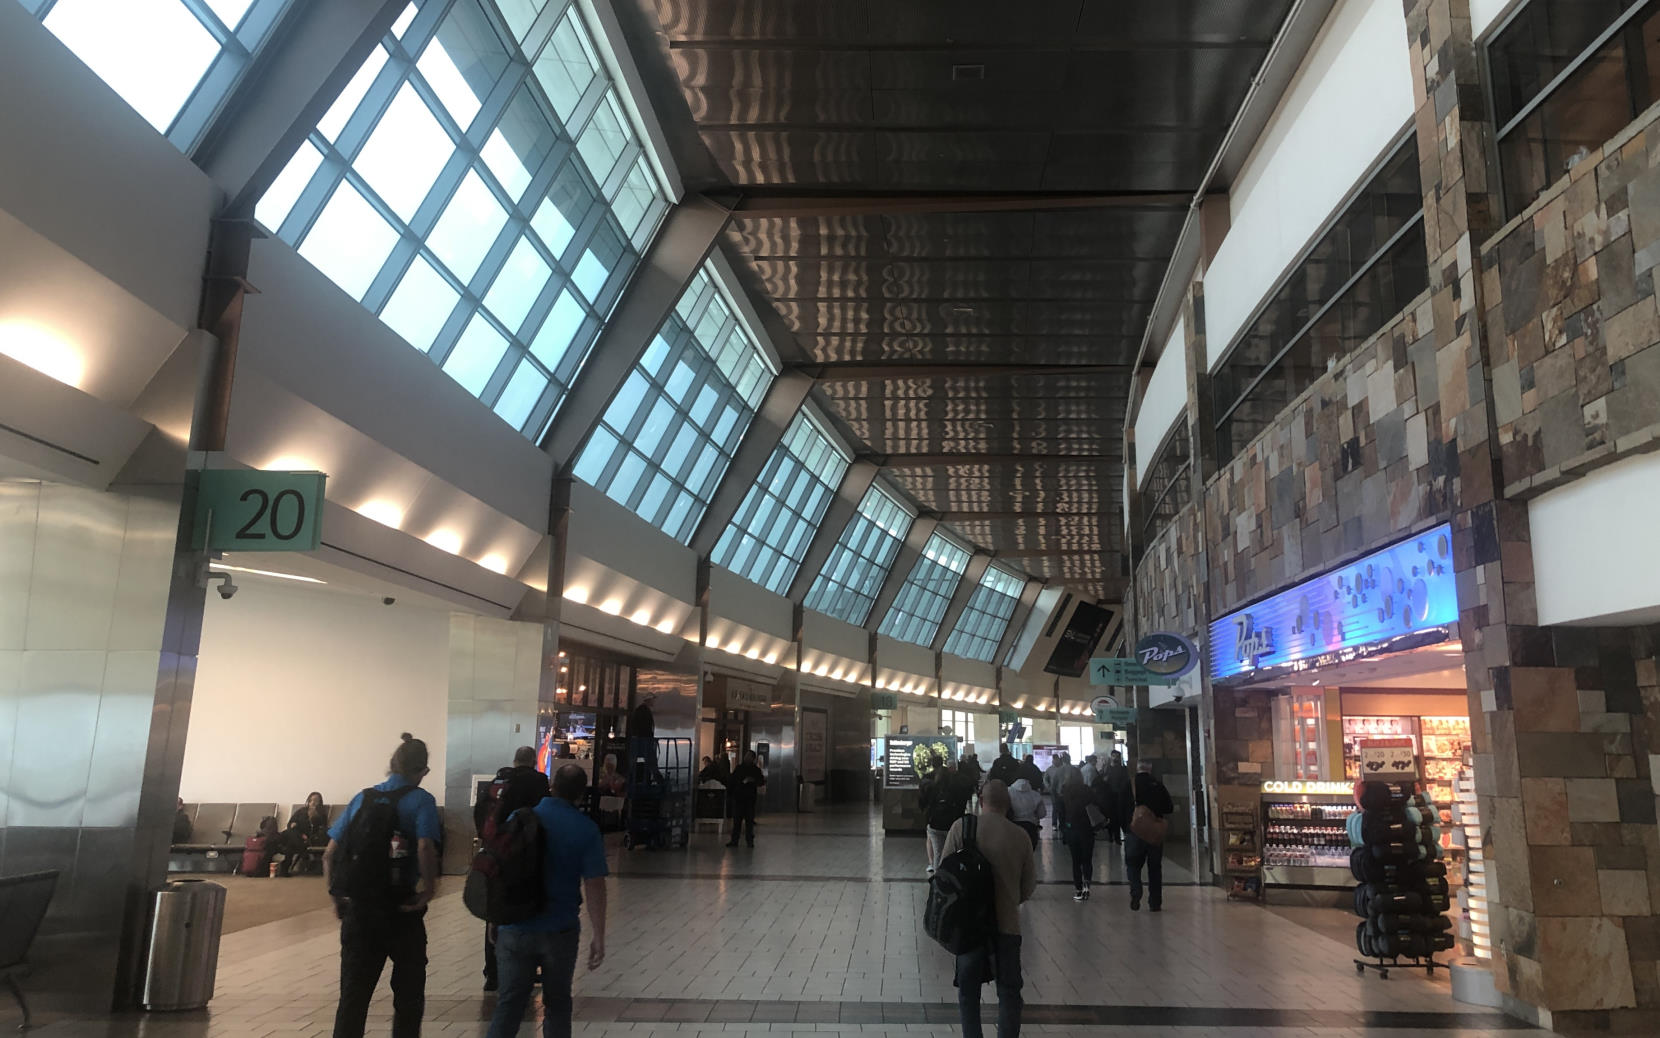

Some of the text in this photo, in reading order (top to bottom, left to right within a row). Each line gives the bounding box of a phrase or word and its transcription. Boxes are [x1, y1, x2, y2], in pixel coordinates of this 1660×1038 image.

[235, 488, 306, 541] 20
[1138, 645, 1186, 665] Pops
[1232, 614, 1274, 665] Pops
[1264, 781, 1302, 792] COLD
